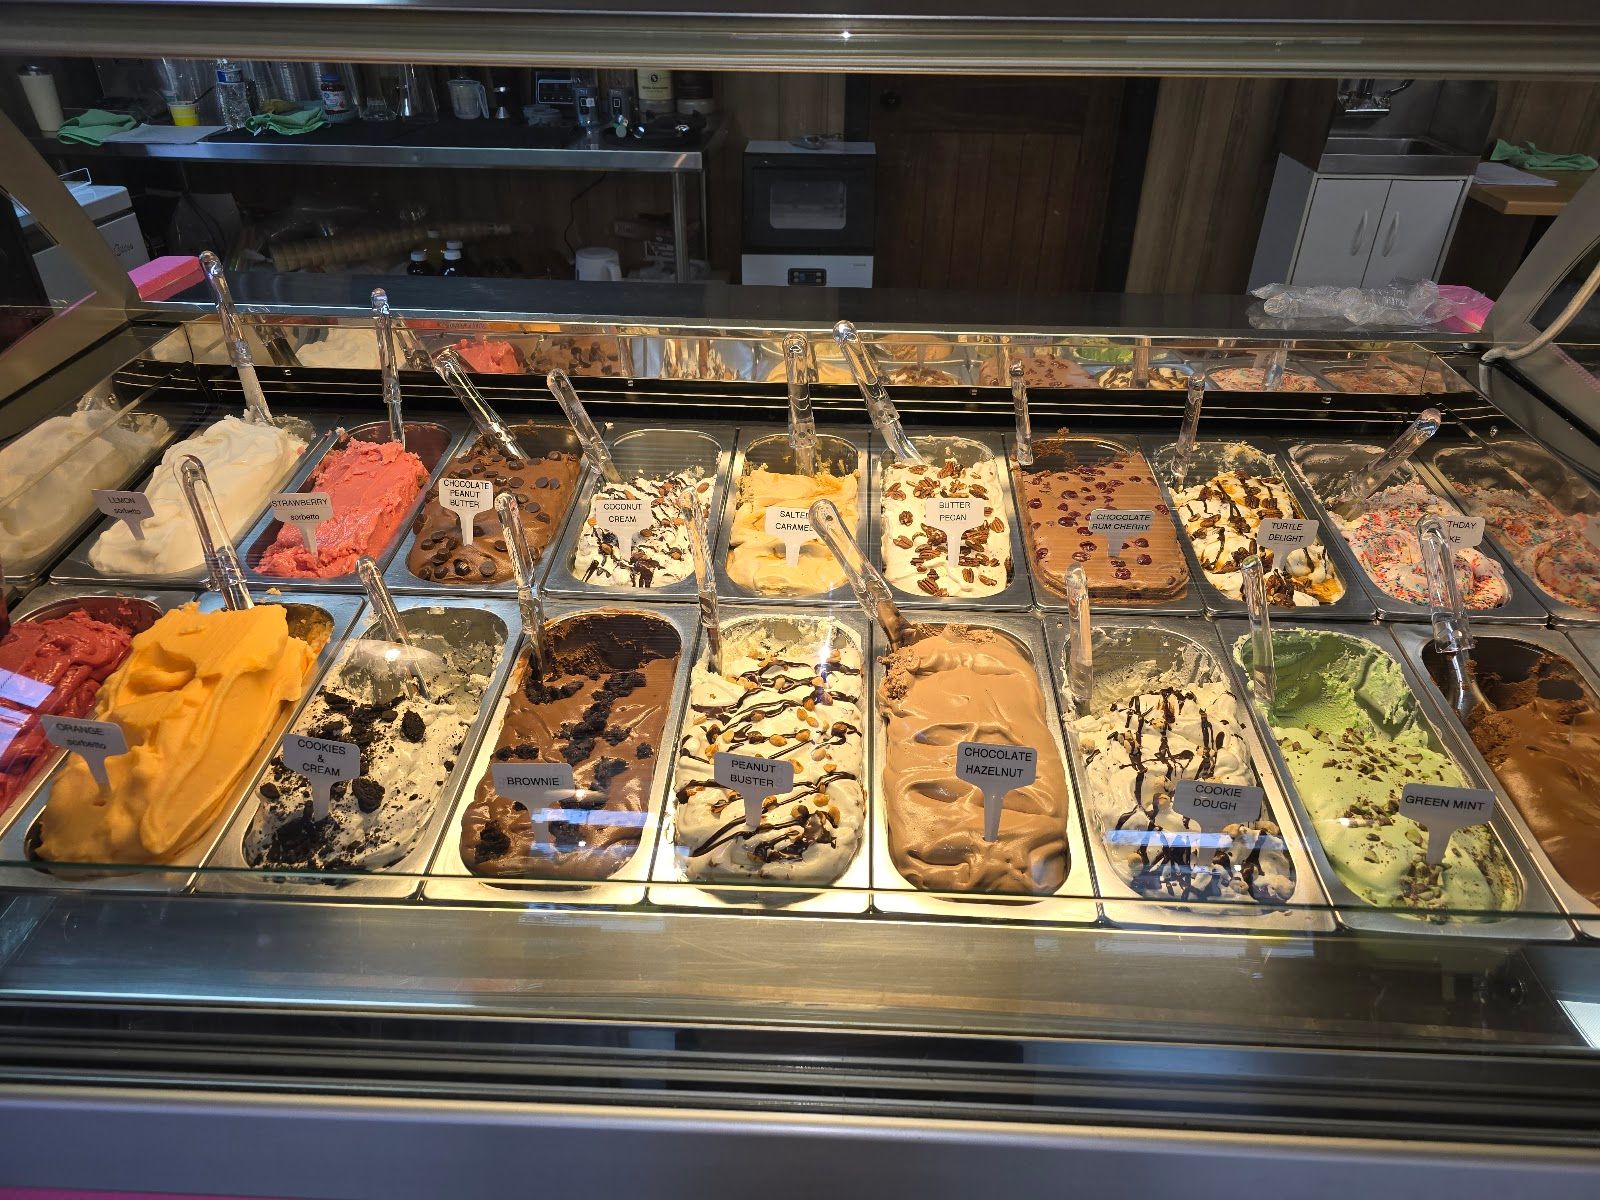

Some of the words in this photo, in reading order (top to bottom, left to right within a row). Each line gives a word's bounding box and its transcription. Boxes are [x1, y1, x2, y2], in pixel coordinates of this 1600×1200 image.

[443, 479, 490, 490] CHOCOLATE
[449, 489, 480, 499] PEANUT
[107, 496, 136, 504] LEMON
[271, 498, 328, 507] STRAWBERRY
[449, 499, 480, 509] BUTTER
[939, 501, 971, 509] BUTTER
[113, 507, 142, 515] sorbetto
[603, 503, 643, 511] COCONUT
[290, 513, 320, 521] sorbetto
[608, 515, 637, 523] CREAM
[939, 514, 967, 522] PECAN
[1096, 513, 1151, 521] CHOCOLATE
[1113, 523, 1150, 531] CHERRY
[1271, 521, 1304, 531] TURTLE
[1447, 520, 1477, 530] THDAY
[1268, 533, 1304, 543] DELIGHT
[55, 723, 105, 736] ORANGE
[297, 738, 346, 755] COOKIES
[317, 754, 325, 763] &
[964, 747, 1033, 762] CHOCOLATE
[302, 762, 341, 777] CREAM
[731, 759, 776, 774] PEANUT
[965, 764, 1024, 778] HAZELNUT
[507, 776, 560, 786] BROWNIE
[730, 773, 774, 788] BUSTER
[1195, 784, 1243, 798] COOKIE
[1193, 798, 1237, 811] DOUGH
[1405, 794, 1450, 808] GREEN
[1452, 800, 1486, 811] MINT
